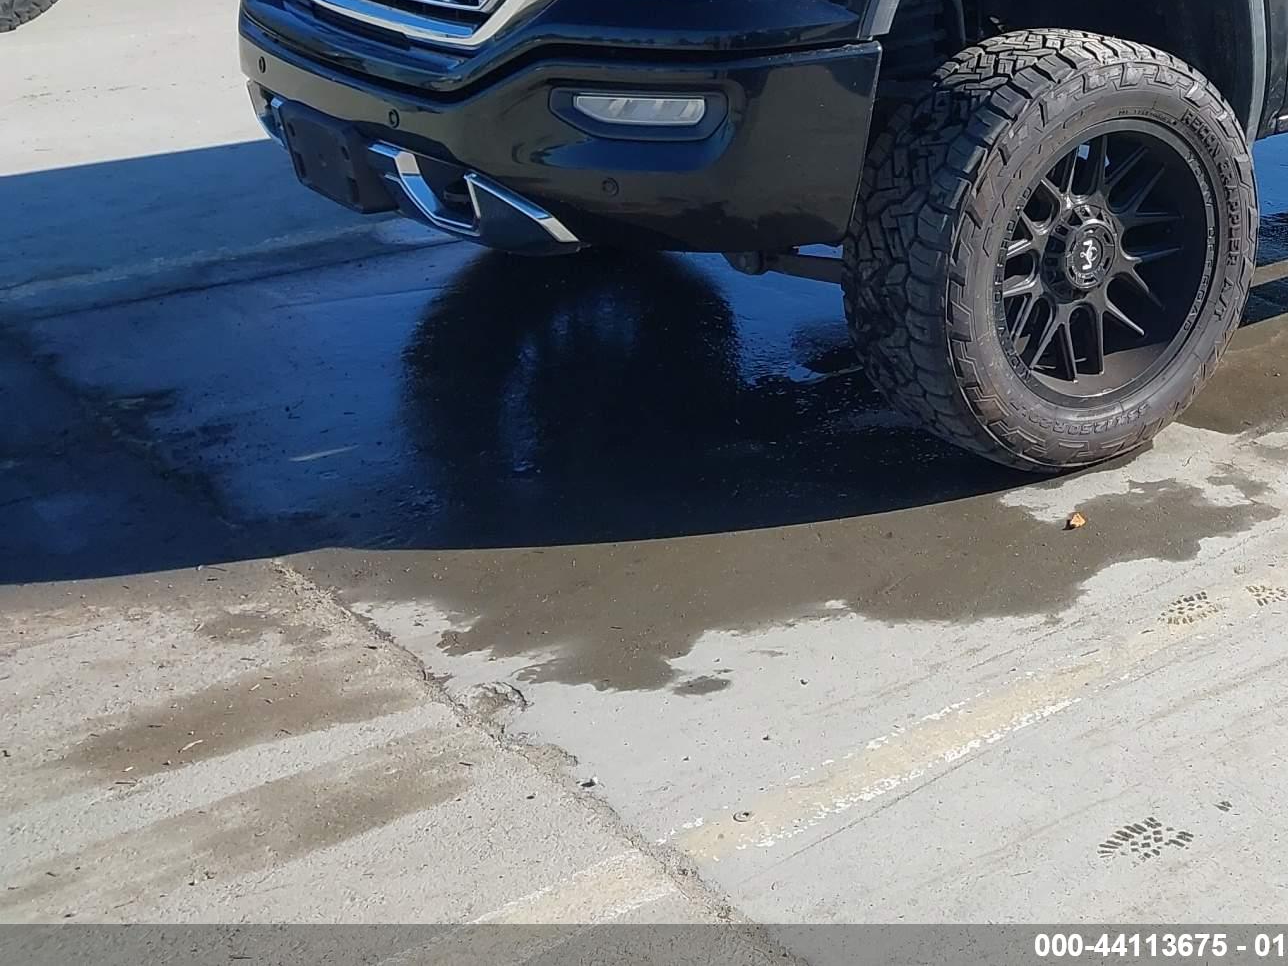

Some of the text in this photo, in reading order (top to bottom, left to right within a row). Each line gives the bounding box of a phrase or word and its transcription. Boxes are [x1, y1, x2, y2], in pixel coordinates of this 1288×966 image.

[1181, 109, 1242, 323] RECON GRAPPLER A/T
